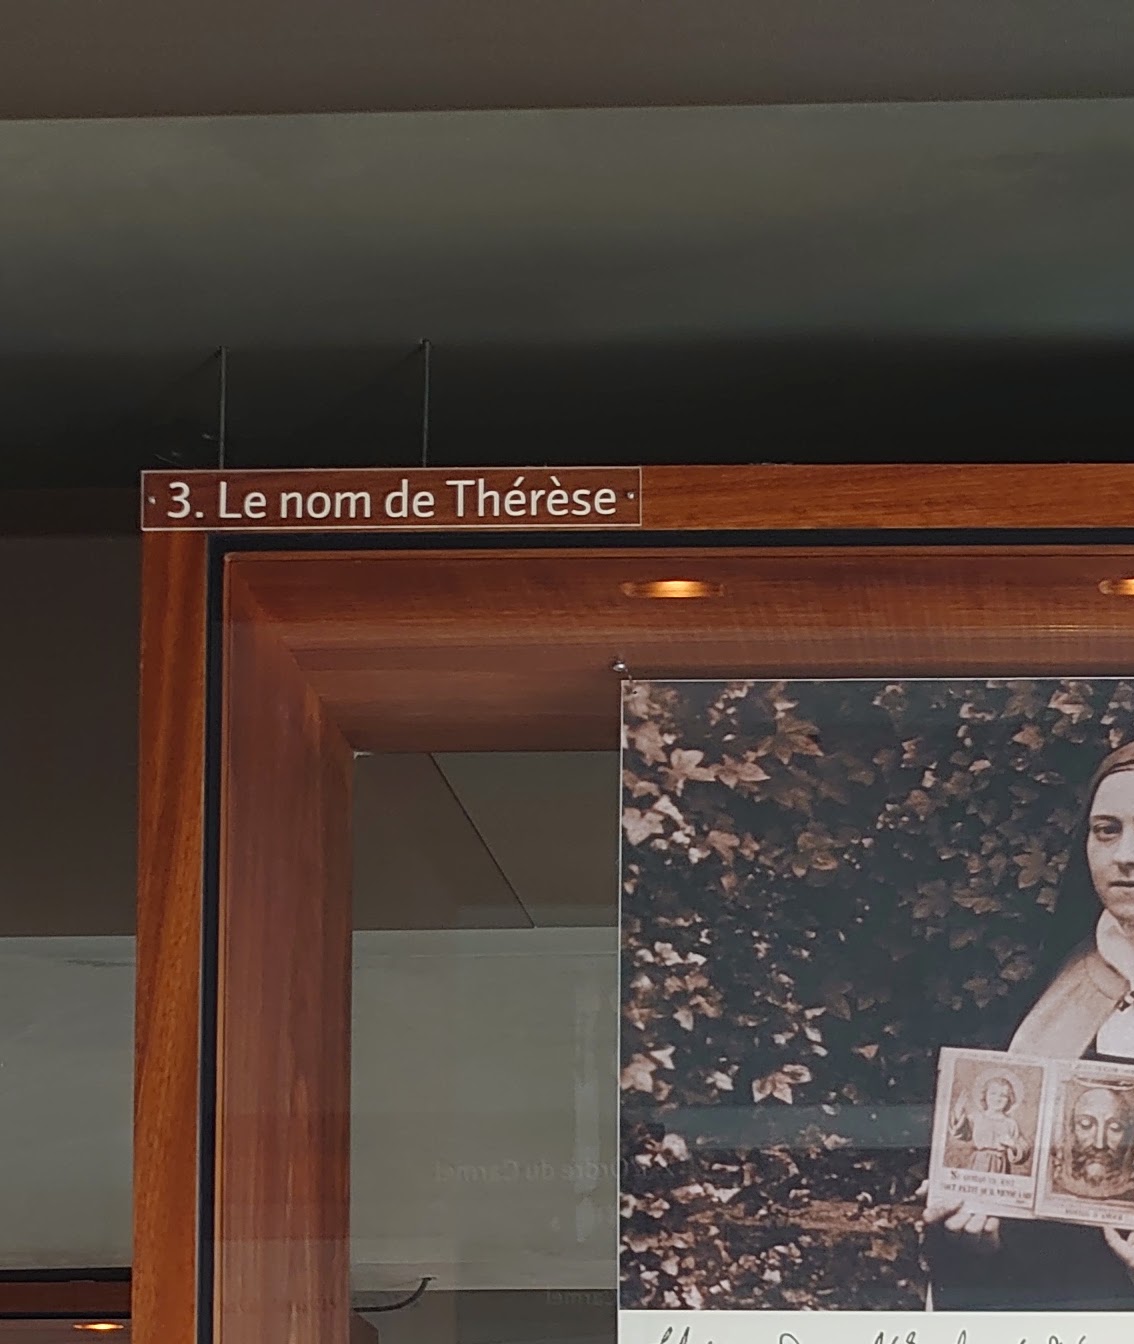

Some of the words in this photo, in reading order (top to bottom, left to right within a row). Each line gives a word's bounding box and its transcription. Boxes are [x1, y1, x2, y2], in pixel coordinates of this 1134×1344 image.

[168, 482, 203, 518] 3.
[219, 481, 266, 518] Le
[281, 492, 370, 518] nom
[385, 479, 434, 517] de
[446, 476, 616, 516] Thérèse
